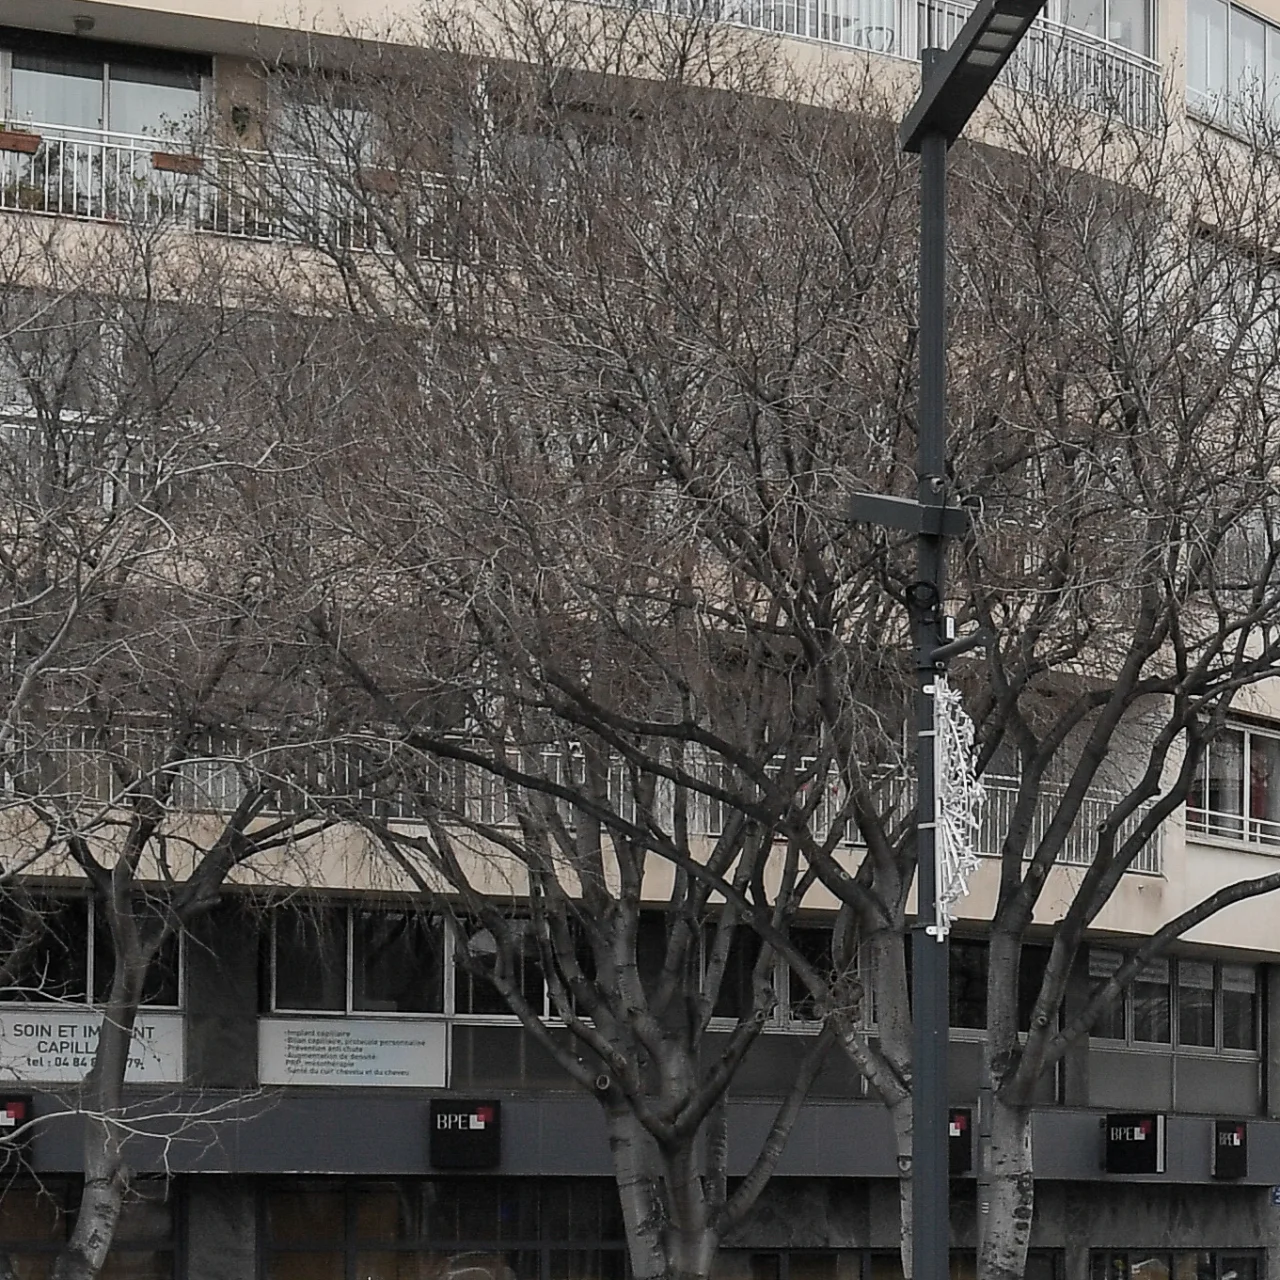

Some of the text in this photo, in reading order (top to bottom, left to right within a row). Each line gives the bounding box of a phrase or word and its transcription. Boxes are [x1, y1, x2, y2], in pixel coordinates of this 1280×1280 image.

[13, 1024, 155, 1039] SOIN ET IMNT
[27, 1057, 43, 1067] tel
[55, 1057, 69, 1067] 04
[73, 1057, 87, 1067] 84
[437, 1113, 468, 1129] BPE
[1111, 1127, 1133, 1140] BPE
